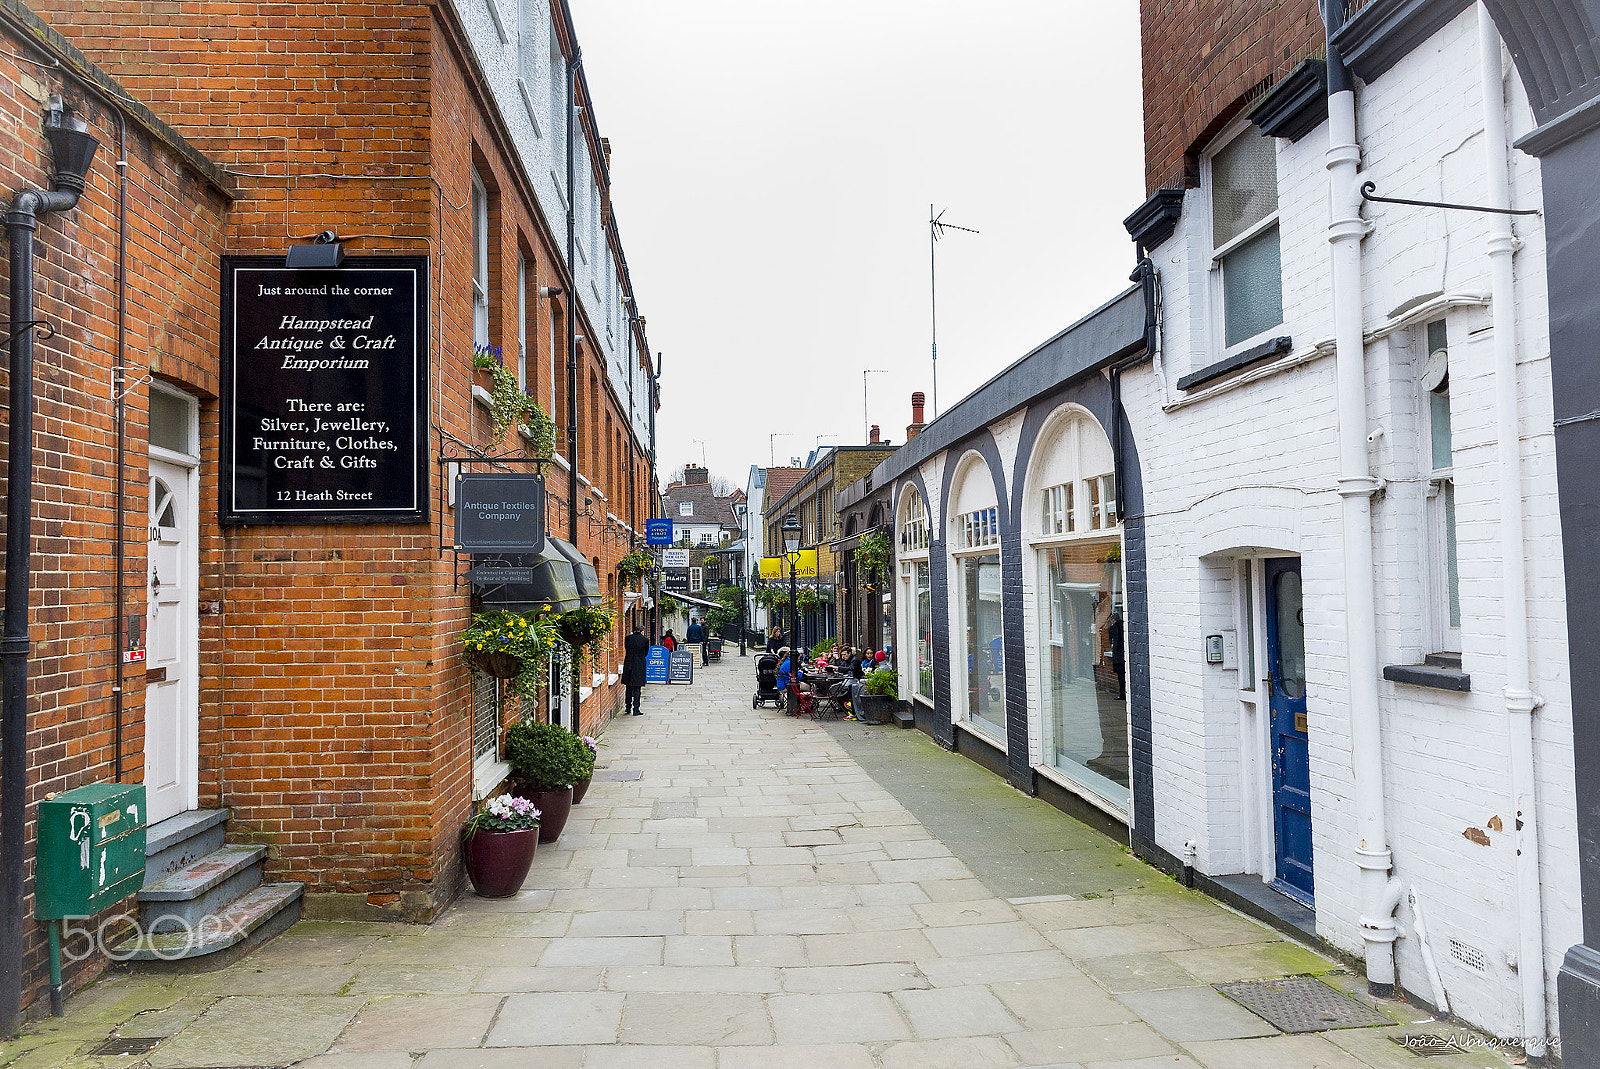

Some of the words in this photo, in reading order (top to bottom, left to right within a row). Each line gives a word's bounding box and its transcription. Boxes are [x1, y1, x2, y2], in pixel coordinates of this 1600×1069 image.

[257, 284, 282, 297] Just
[284, 284, 328, 296] around
[331, 284, 350, 296] the
[353, 286, 394, 296] corner
[279, 315, 374, 331] Hampstead
[253, 335, 324, 353] Antique
[329, 335, 346, 350] &
[352, 334, 397, 350] Craft
[280, 354, 370, 372] Emporium
[286, 398, 332, 412] There
[336, 401, 365, 412] are:
[260, 417, 310, 433] Silver,
[313, 417, 390, 434] Jewellery,
[252, 436, 331, 452] Furniture,
[335, 436, 398, 452] Clothes,
[274, 455, 315, 469] Craft
[319, 455, 336, 469] &
[339, 454, 377, 469] Gifts
[276, 489, 292, 501] 12
[295, 489, 334, 501] Heath
[337, 489, 373, 501] Street
[463, 501, 499, 511] Antique
[501, 502, 536, 510] Textiles
[478, 511, 521, 522] Company
[148, 526, 162, 542] 10A
[794, 565, 816, 576] avills
